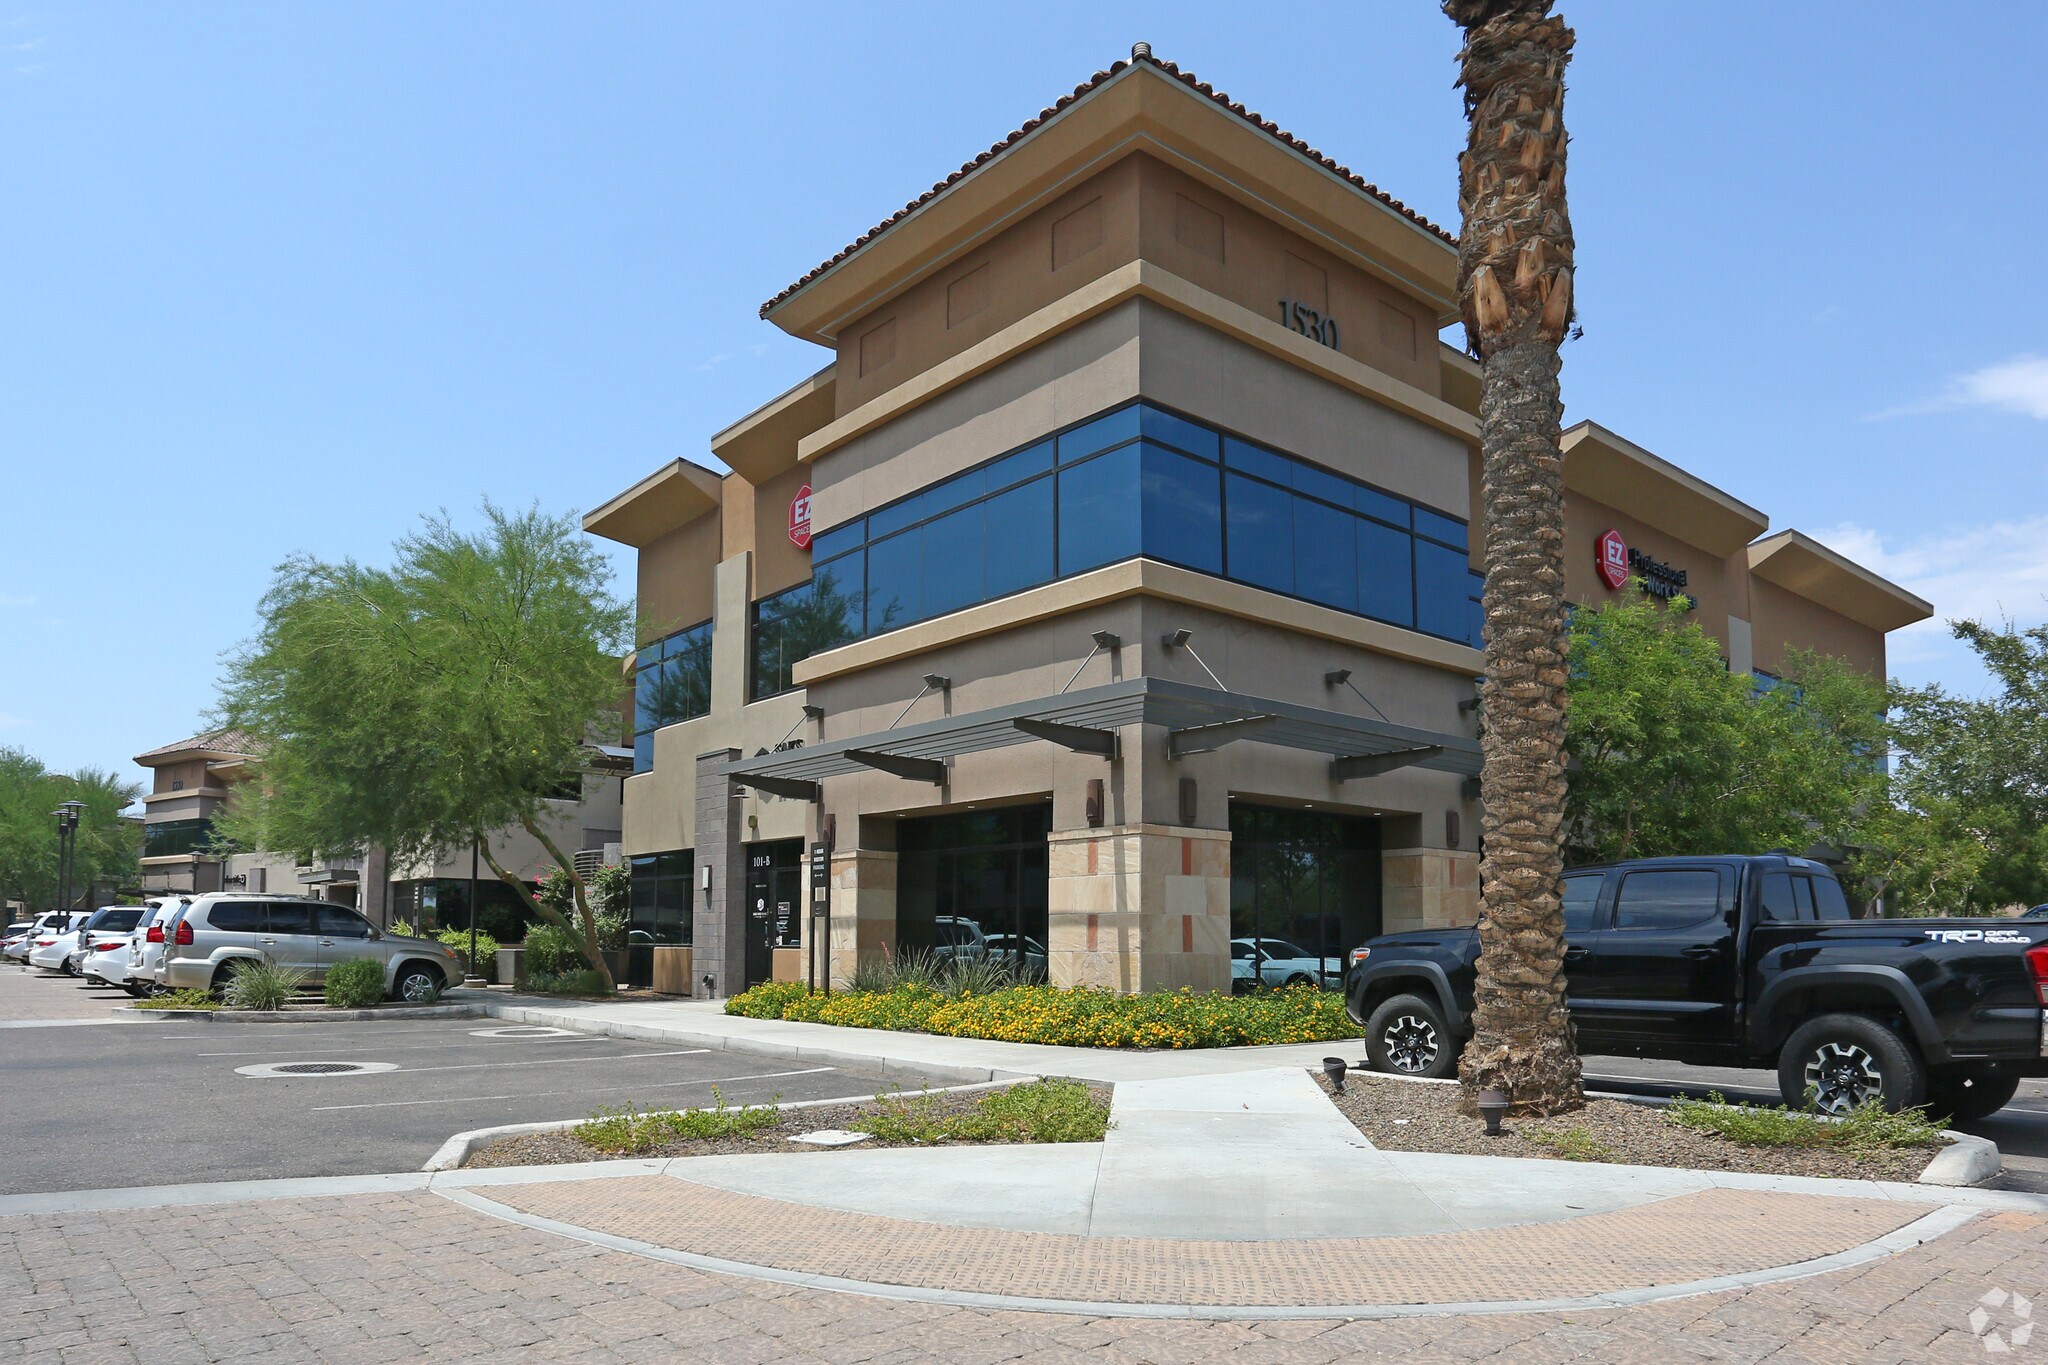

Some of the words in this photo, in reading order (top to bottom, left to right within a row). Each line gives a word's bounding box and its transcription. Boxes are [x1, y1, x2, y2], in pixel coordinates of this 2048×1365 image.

[1278, 298, 1342, 352] 1530
[794, 495, 812, 525] EZ
[1607, 539, 1624, 566] EZ
[1608, 566, 1625, 579] SPACES
[753, 855, 771, 867] 101-B
[1924, 930, 1984, 944] TRD
[1984, 936, 2032, 944] ROAD
